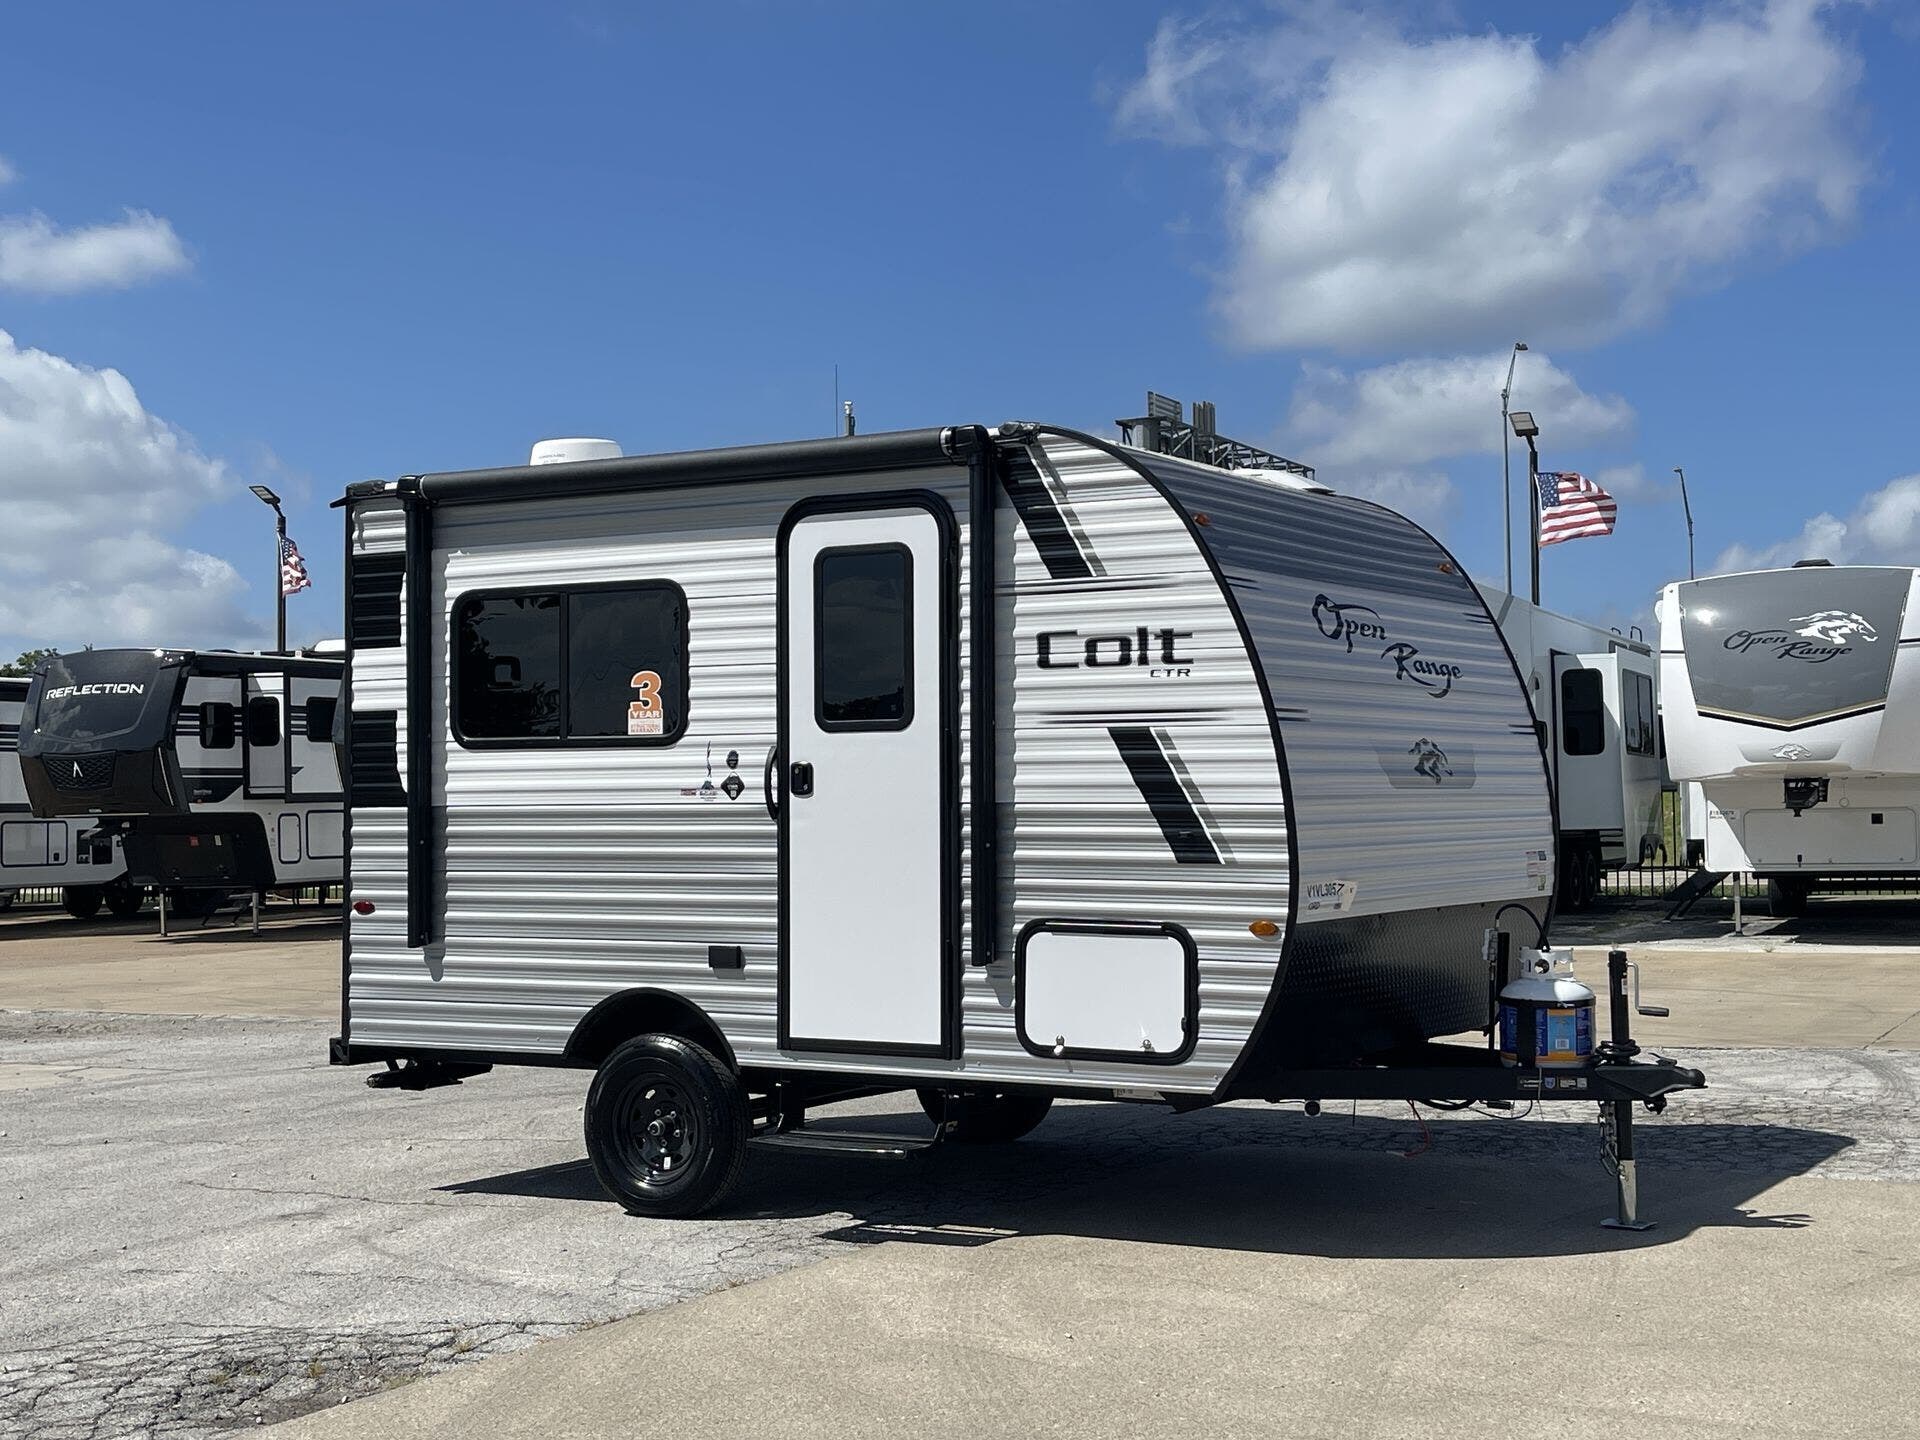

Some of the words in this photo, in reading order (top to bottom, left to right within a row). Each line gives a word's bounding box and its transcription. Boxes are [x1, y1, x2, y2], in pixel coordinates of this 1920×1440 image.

[1036, 625, 1194, 670] Colt
[1312, 593, 1387, 653] Open
[1380, 642, 1463, 698] Range
[1723, 629, 1791, 654] Open
[1771, 640, 1853, 664] Range
[630, 671, 662, 711] 3
[1150, 668, 1191, 677] CTR
[46, 683, 144, 700] REFLECTION
